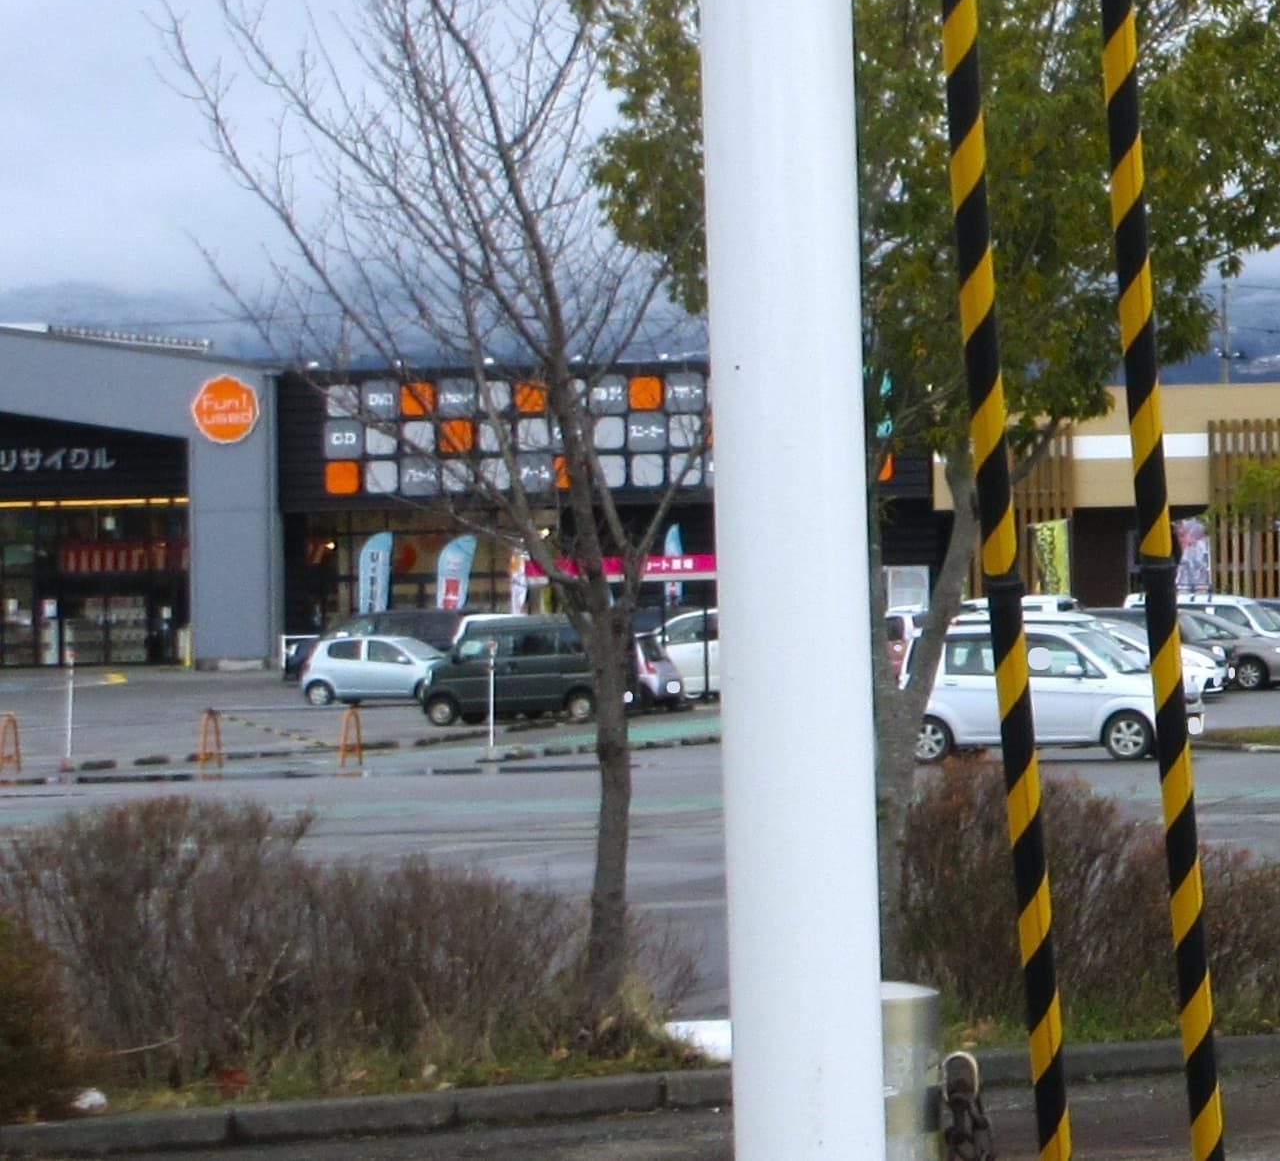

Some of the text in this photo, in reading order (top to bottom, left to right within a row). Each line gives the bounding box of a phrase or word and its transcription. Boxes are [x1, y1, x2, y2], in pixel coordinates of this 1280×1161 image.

[202, 393, 247, 411] Fun!
[0, 447, 116, 471] リサイクル
